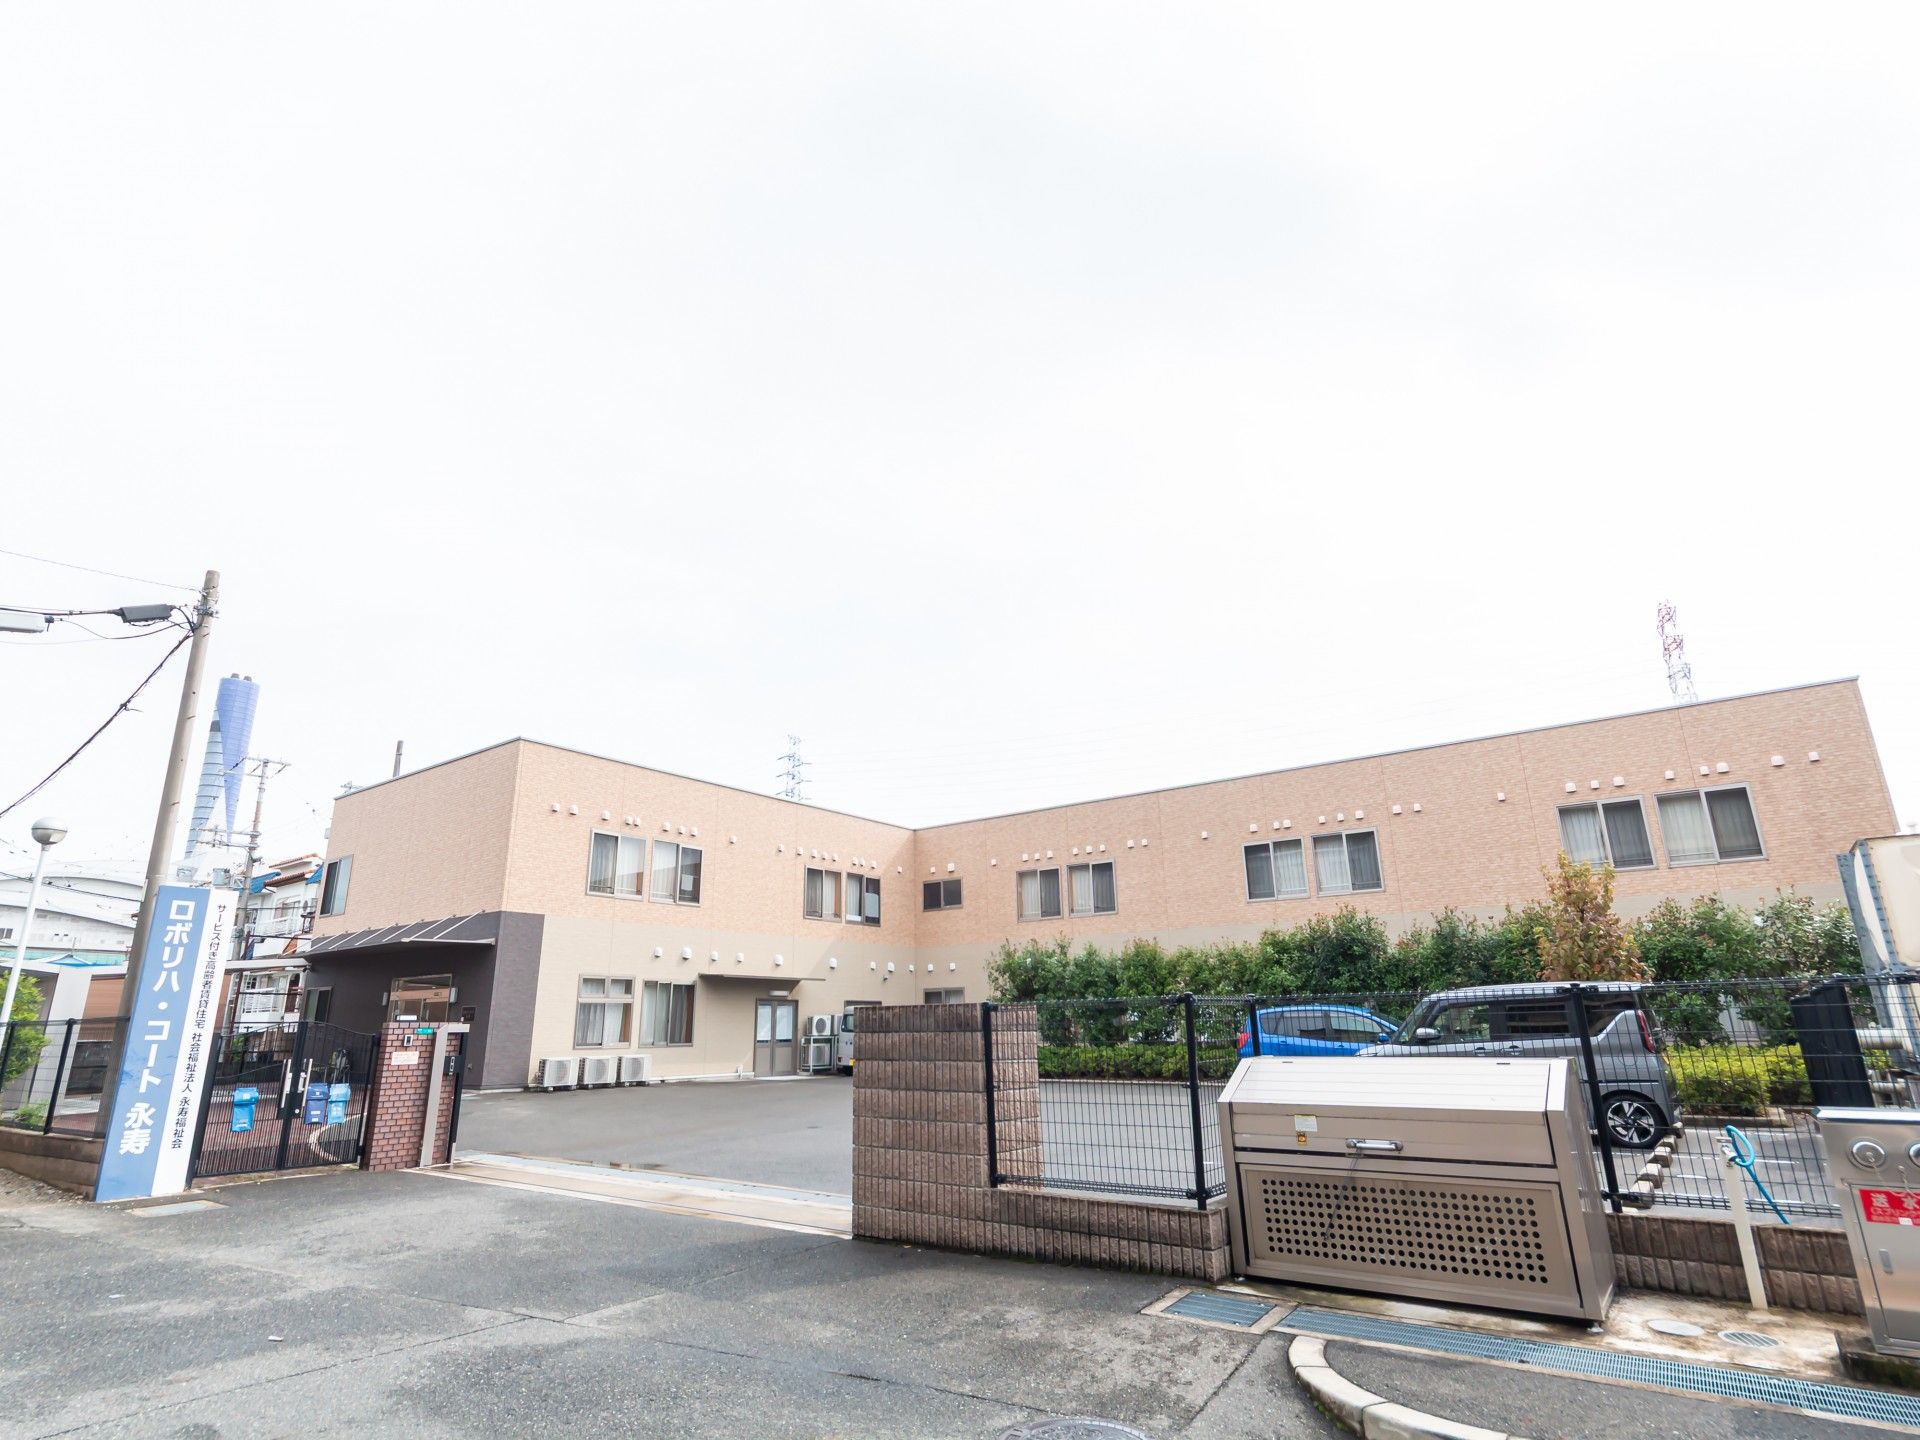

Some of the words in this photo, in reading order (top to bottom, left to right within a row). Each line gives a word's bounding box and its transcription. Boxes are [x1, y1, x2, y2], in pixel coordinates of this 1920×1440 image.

[181, 1033, 203, 1093] 社会福祉法人
[119, 1102, 156, 1155] 永寿
[171, 1096, 191, 1149] 永寿福祉会
